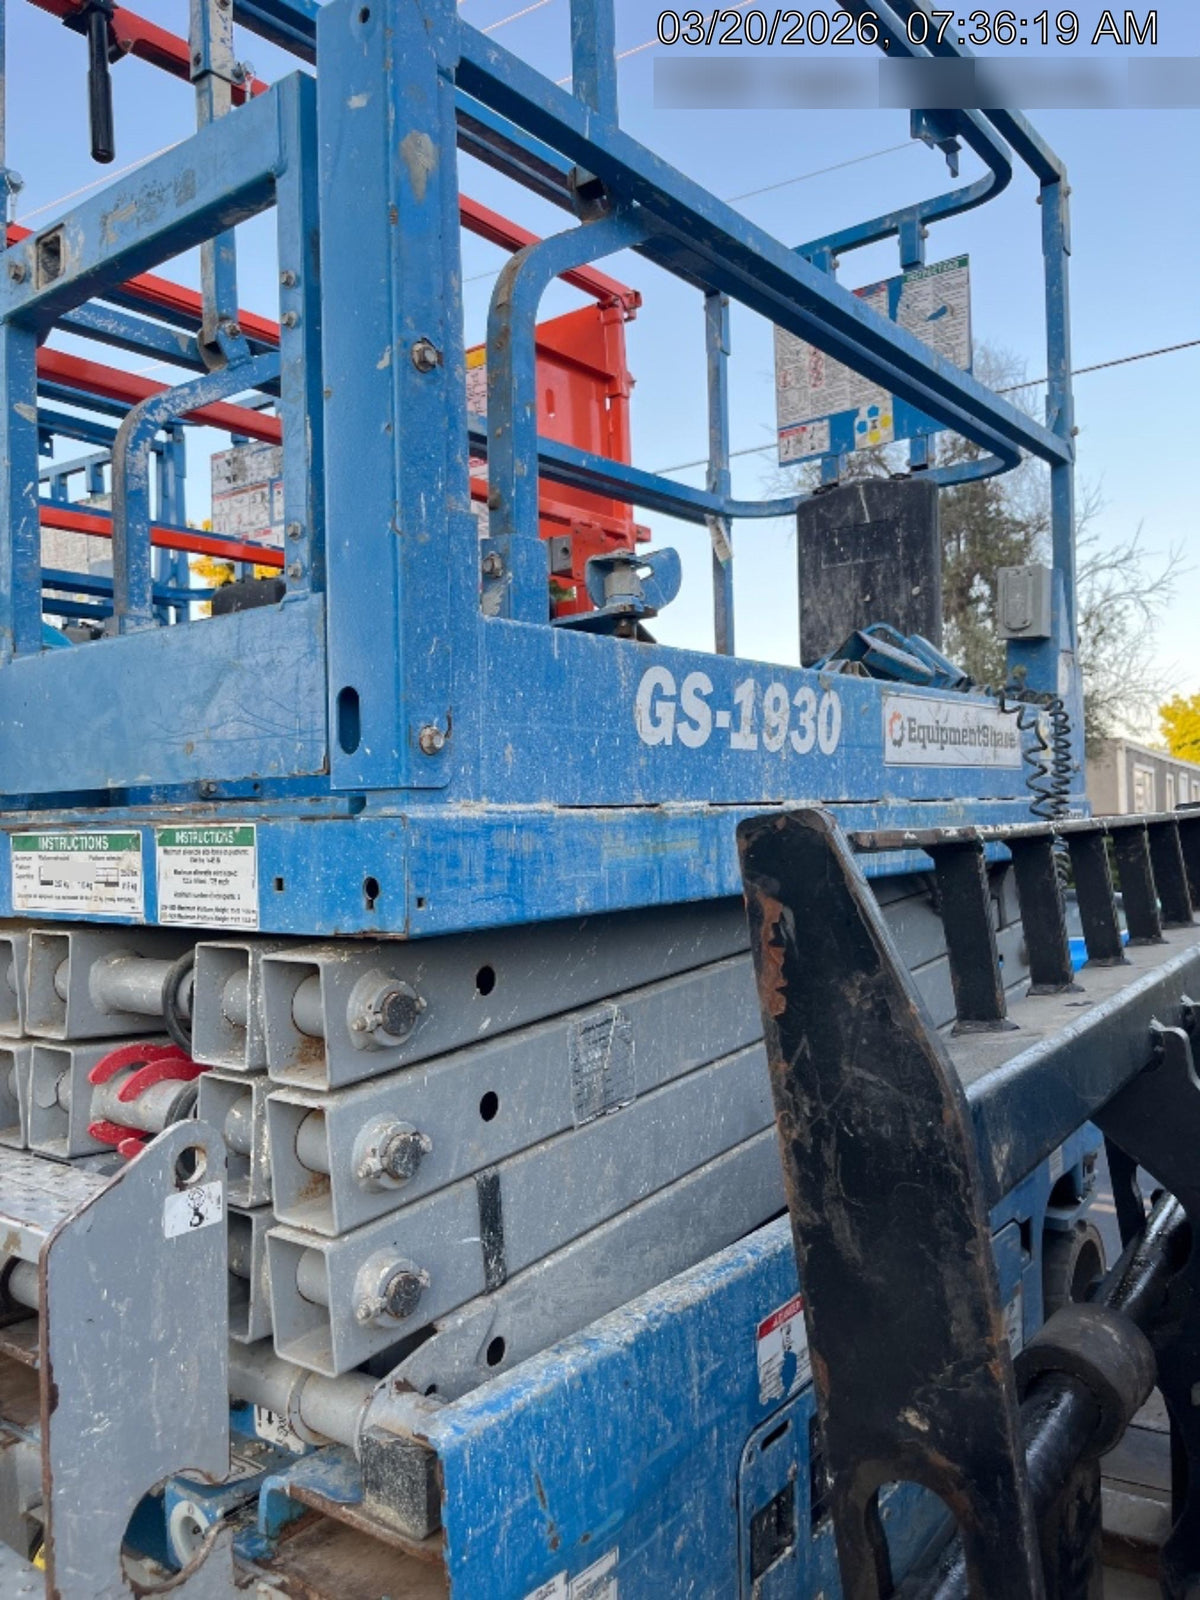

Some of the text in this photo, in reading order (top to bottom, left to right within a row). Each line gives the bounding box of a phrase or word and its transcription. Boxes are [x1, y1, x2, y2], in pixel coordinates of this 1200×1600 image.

[634, 666, 842, 756] GS-1930
[38, 835, 109, 850] INSTRUCTIONS
[175, 831, 235, 844] INSTRUCTIONS
